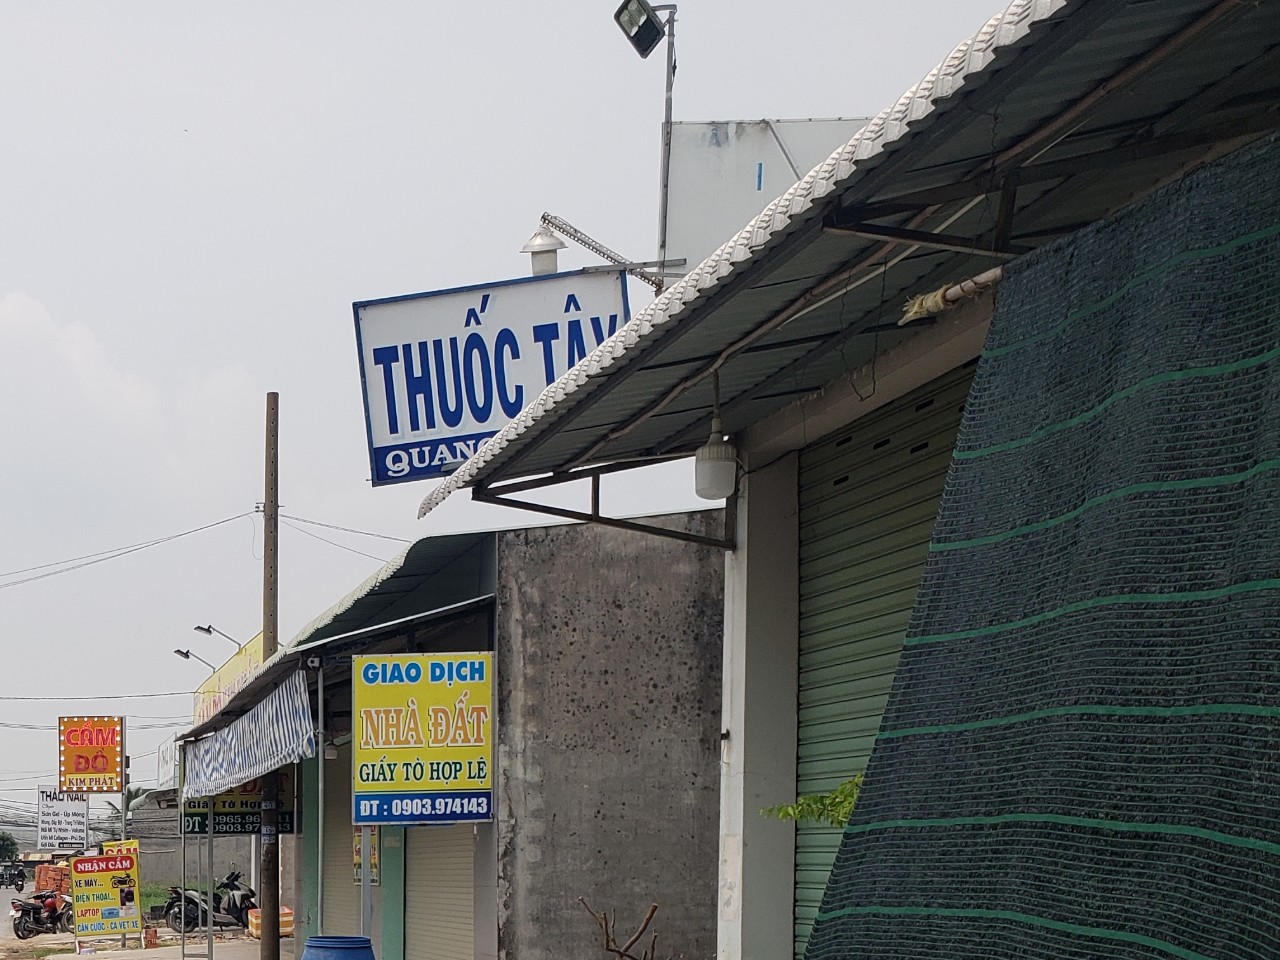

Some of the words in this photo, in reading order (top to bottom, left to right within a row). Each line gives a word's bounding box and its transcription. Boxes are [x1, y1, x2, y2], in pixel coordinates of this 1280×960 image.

[373, 294, 523, 435] THUỐC
[385, 438, 492, 477] QUAN
[362, 662, 422, 684] GIAO
[430, 661, 485, 686] DỊCH
[361, 698, 424, 748] NHÀ
[429, 690, 489, 747] ĐẤT
[65, 721, 116, 747] CẦM
[75, 748, 109, 773] ĐỒ
[359, 756, 398, 782] GIẤY
[402, 757, 425, 781] TỜ
[429, 761, 463, 785] HỢP
[467, 757, 487, 784] LỆ
[68, 777, 86, 786] KIM
[89, 775, 115, 786] PHÁT
[67, 793, 86, 801] NAIL
[360, 800, 380, 816] ĐT
[392, 798, 488, 816] 0903.974143
[77, 860, 106, 873] NHẬN
[108, 857, 131, 870] CẦM
[75, 879, 83, 888] XE
[77, 908, 100, 918] LAPTOP
[131, 920, 139, 929] XE
